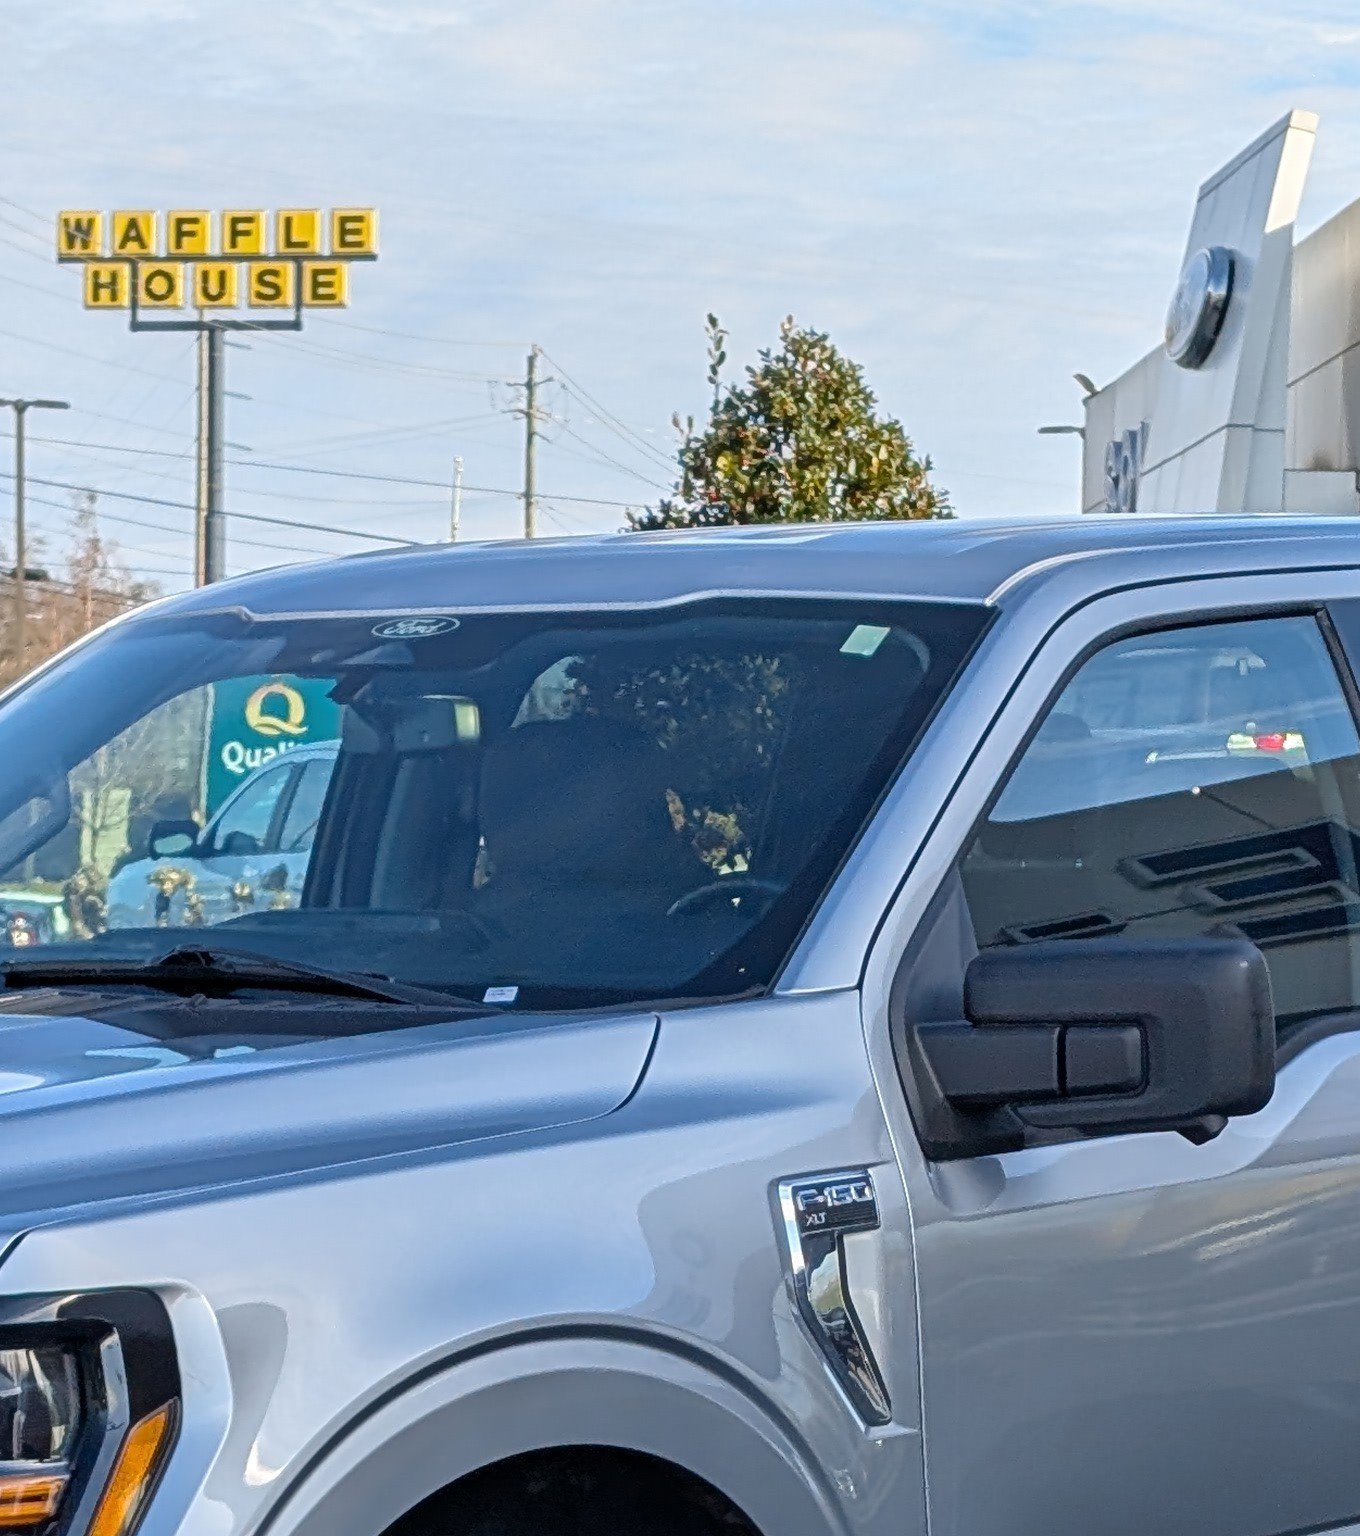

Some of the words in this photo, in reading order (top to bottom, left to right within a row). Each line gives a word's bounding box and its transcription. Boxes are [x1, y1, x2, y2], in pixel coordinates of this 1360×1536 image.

[62, 213, 366, 251] WAFFLE
[91, 267, 338, 304] HOUSE
[382, 618, 448, 635] Ford
[220, 741, 296, 774] Qual
[796, 1182, 873, 1211] F-150
[805, 1211, 827, 1227] XLT
